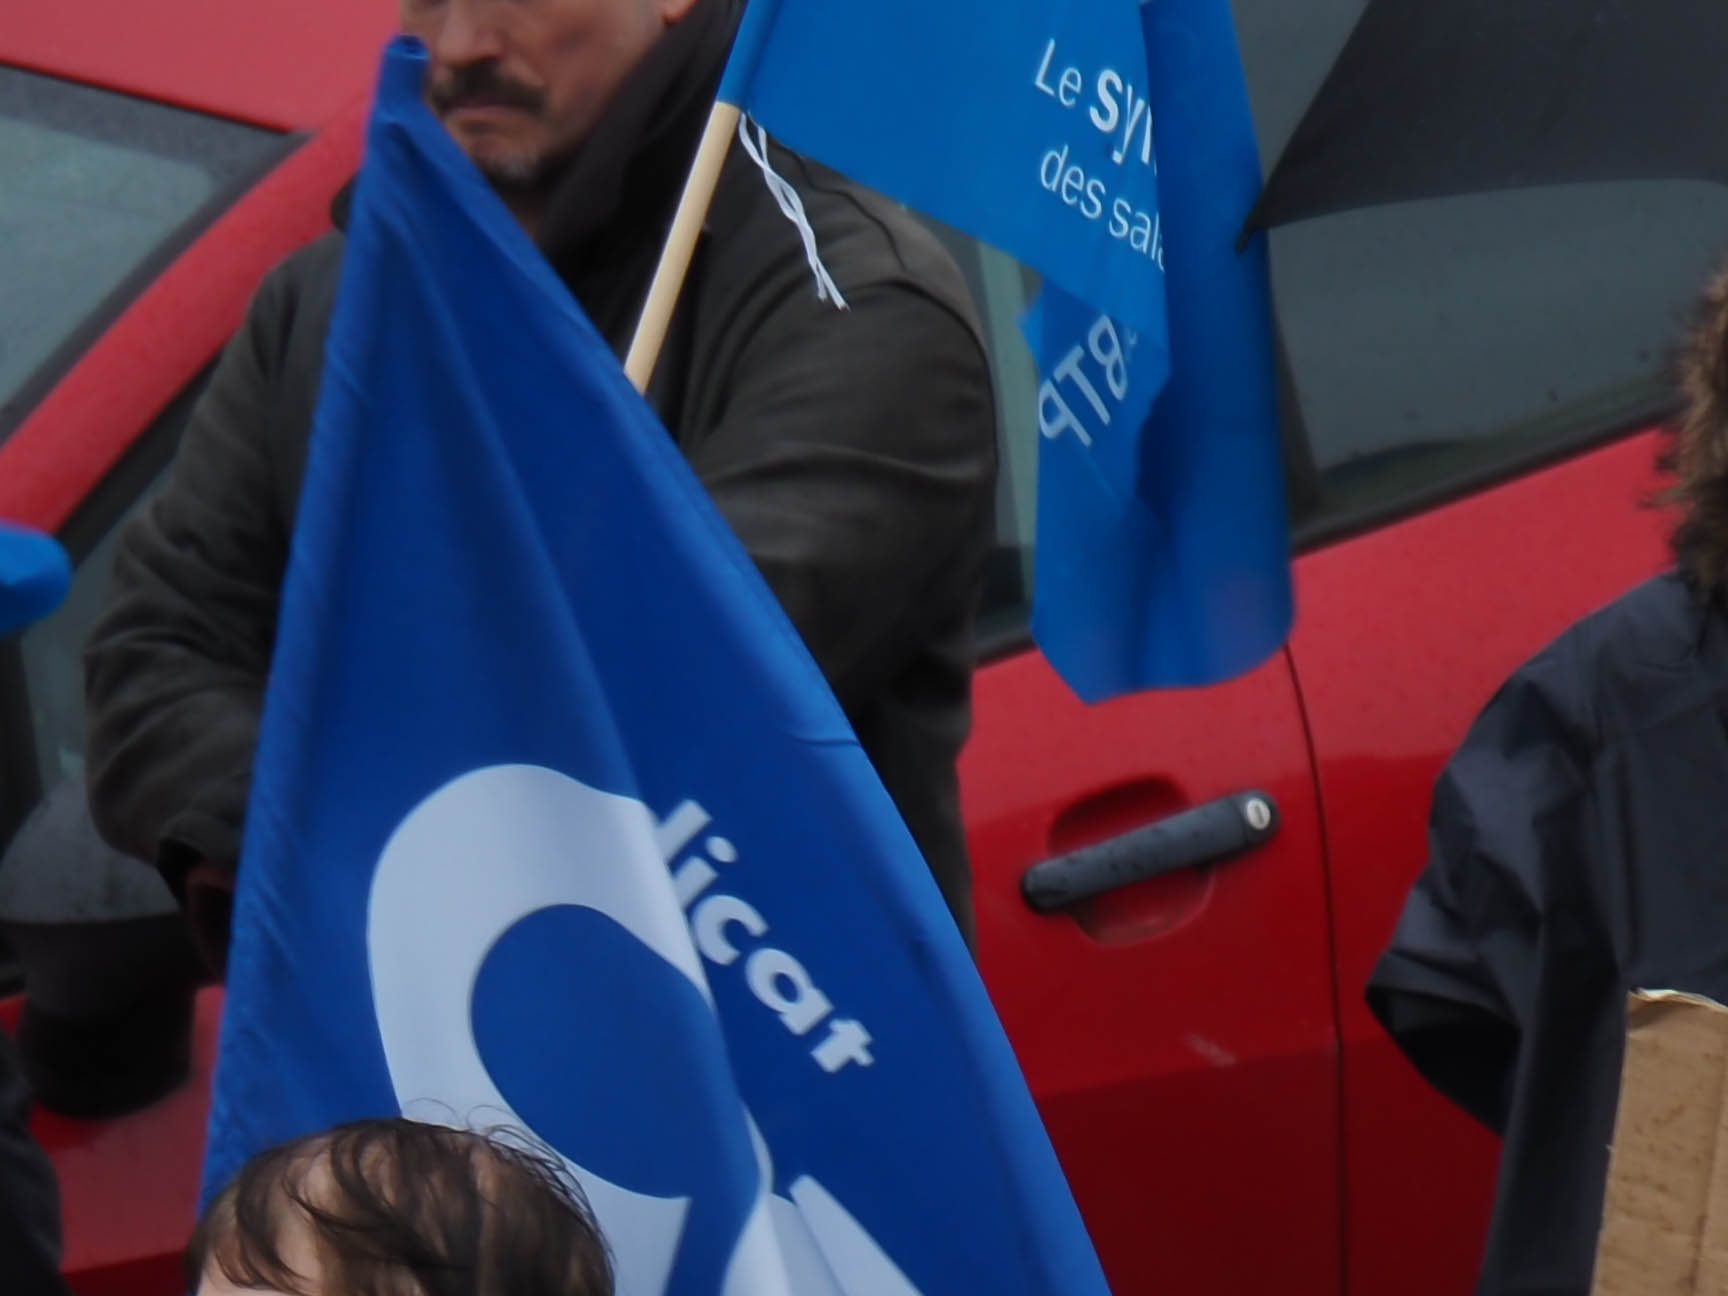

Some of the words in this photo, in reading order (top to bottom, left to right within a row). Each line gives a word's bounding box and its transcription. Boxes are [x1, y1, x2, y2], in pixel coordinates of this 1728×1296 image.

[1035, 38, 1083, 107] Le
[1040, 145, 1106, 219] des
[1109, 197, 1165, 272] sal
